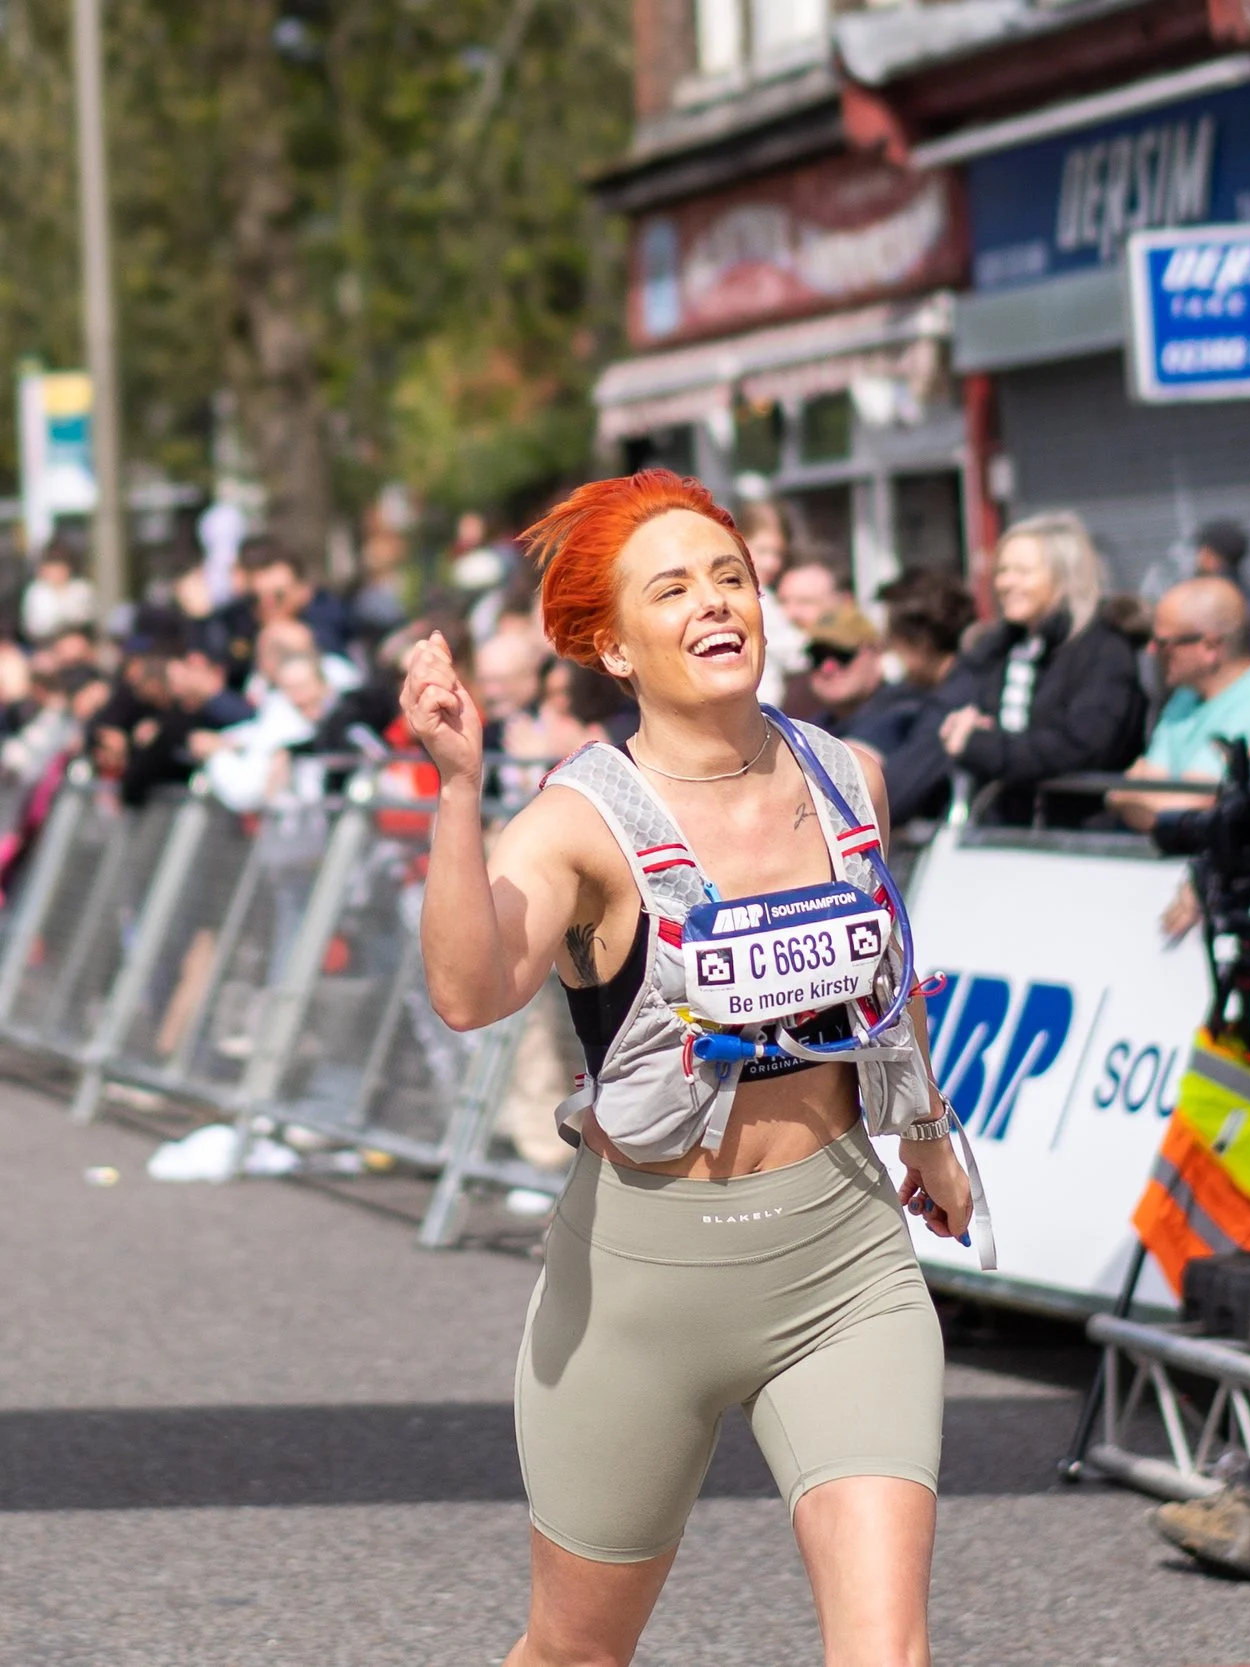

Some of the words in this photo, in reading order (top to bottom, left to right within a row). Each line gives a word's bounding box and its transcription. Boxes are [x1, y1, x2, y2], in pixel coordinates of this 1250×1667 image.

[712, 903, 763, 934] ABP
[771, 892, 856, 918] SOUTHAMPTON
[750, 943, 766, 979] C
[773, 931, 836, 976] 6633
[729, 996, 753, 1013] Be
[760, 988, 804, 1009] more
[810, 975, 859, 999] kirsty
[702, 1207, 783, 1223] BLAKELY
